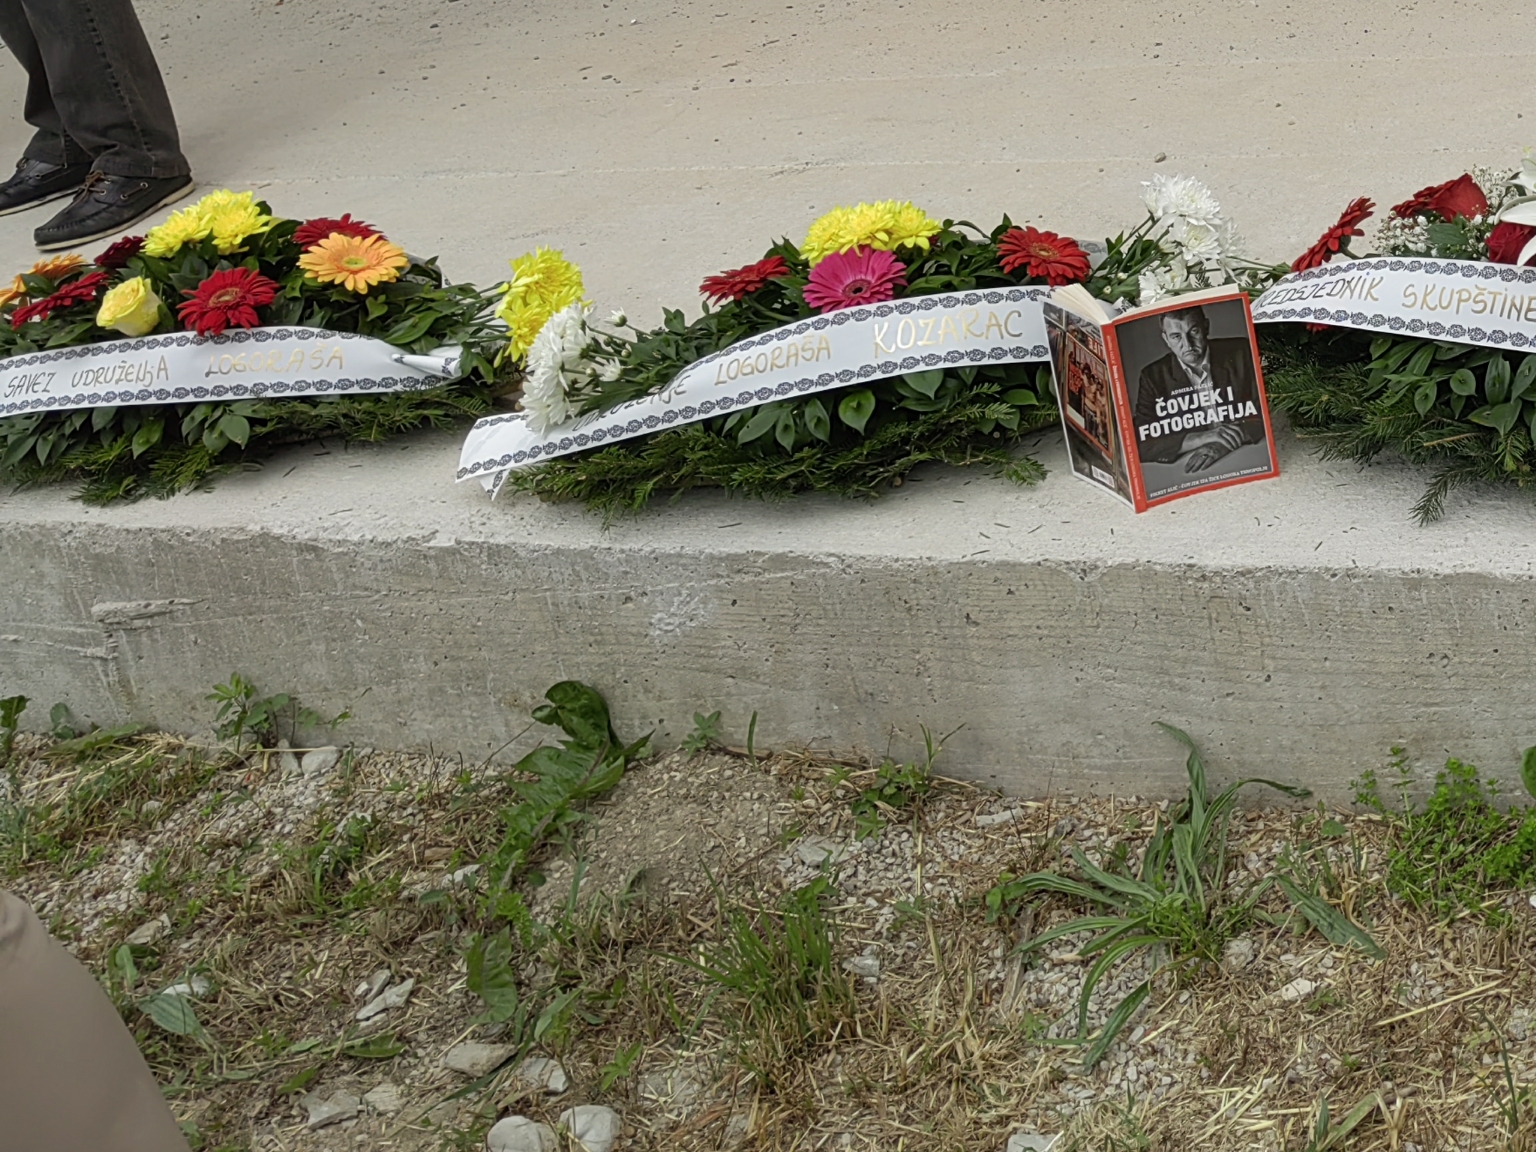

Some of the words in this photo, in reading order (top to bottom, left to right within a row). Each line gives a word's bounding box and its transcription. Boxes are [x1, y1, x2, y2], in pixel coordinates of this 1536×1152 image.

[4, 371, 57, 398] SAVEZ
[204, 341, 345, 379] LOGORAŠA
[713, 333, 832, 386] LOGORAŠA
[872, 309, 1024, 359] KOZARAC
[1138, 400, 1258, 442] FOTOGRAFIJA
[1155, 387, 1224, 417] ČOVJEK
[1226, 385, 1234, 402] I
